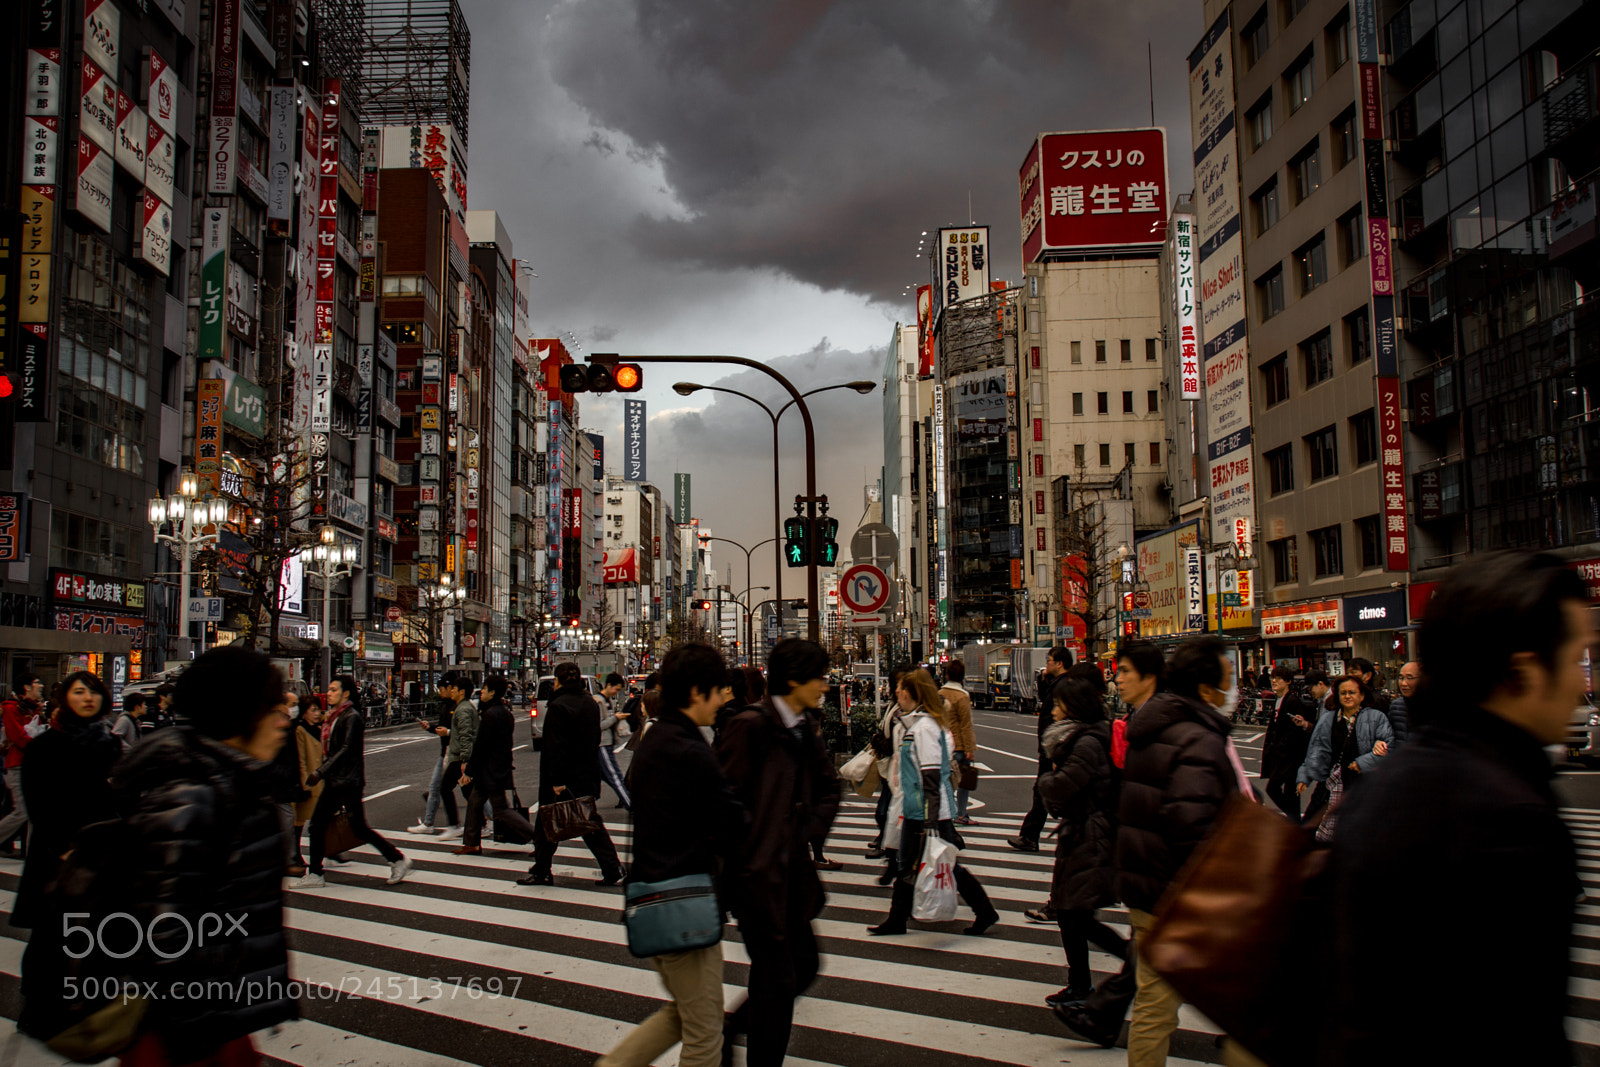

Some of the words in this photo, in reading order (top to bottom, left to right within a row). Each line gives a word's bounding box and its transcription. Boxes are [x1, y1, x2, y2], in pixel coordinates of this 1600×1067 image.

[1202, 29, 1216, 54] 6F
[49, 51, 60, 60] 5F
[151, 55, 161, 71] 9F
[83, 63, 96, 79] 4F
[36, 62, 50, 109] 手羽一郎
[83, 95, 114, 135] 北の家族
[118, 94, 128, 112] 5F
[45, 118, 57, 127] 4F
[148, 124, 159, 140] 6F
[214, 117, 233, 127] 全品
[80, 140, 91, 158] B1
[1206, 127, 1220, 151] 5F
[34, 129, 47, 177] 北の家族
[1059, 149, 1145, 169] クスリの
[148, 157, 174, 186] ロックアップ
[79, 175, 112, 211] ミステリアス
[145, 195, 155, 210] 2F
[1049, 181, 1160, 217] 龍生堂
[145, 227, 170, 252] アラビアン
[949, 232, 978, 243] 389
[151, 248, 165, 264] ロック
[960, 245, 969, 286] SHINJUKU
[971, 244, 983, 270] NEW
[1176, 219, 1193, 316] 新宿サンパーク
[1202, 276, 1218, 302] Nice
[1376, 281, 1386, 289] 3F
[203, 280, 221, 325] レイク
[323, 306, 332, 323] 名物
[33, 324, 48, 335] B1F
[1181, 326, 1198, 393] 三平本館
[22, 344, 36, 409] ミステリアス
[203, 382, 219, 391] 激安
[315, 349, 329, 413] パーティー
[201, 399, 209, 422] セット
[210, 396, 219, 420] フリー
[234, 386, 262, 424] レイク
[359, 389, 370, 426] 747
[199, 425, 217, 458] 麻雀
[630, 414, 641, 480] オザキクリニック
[313, 460, 326, 499] ダーツ
[1212, 461, 1235, 489] 三平ストア
[1382, 392, 1406, 555] クスリの龍生堂薬局
[1421, 471, 1439, 519] 生堂
[573, 496, 581, 529] SHIDAX
[56, 576, 70, 595] 4F
[86, 579, 123, 606] 北の家族
[1188, 553, 1200, 610] 三平ストア
[127, 586, 137, 603] 24
[211, 600, 218, 610] P
[929, 603, 937, 623] KFC
[1359, 605, 1386, 620] atmos
[1265, 623, 1280, 635] GAME
[1317, 619, 1335, 632] GAME
